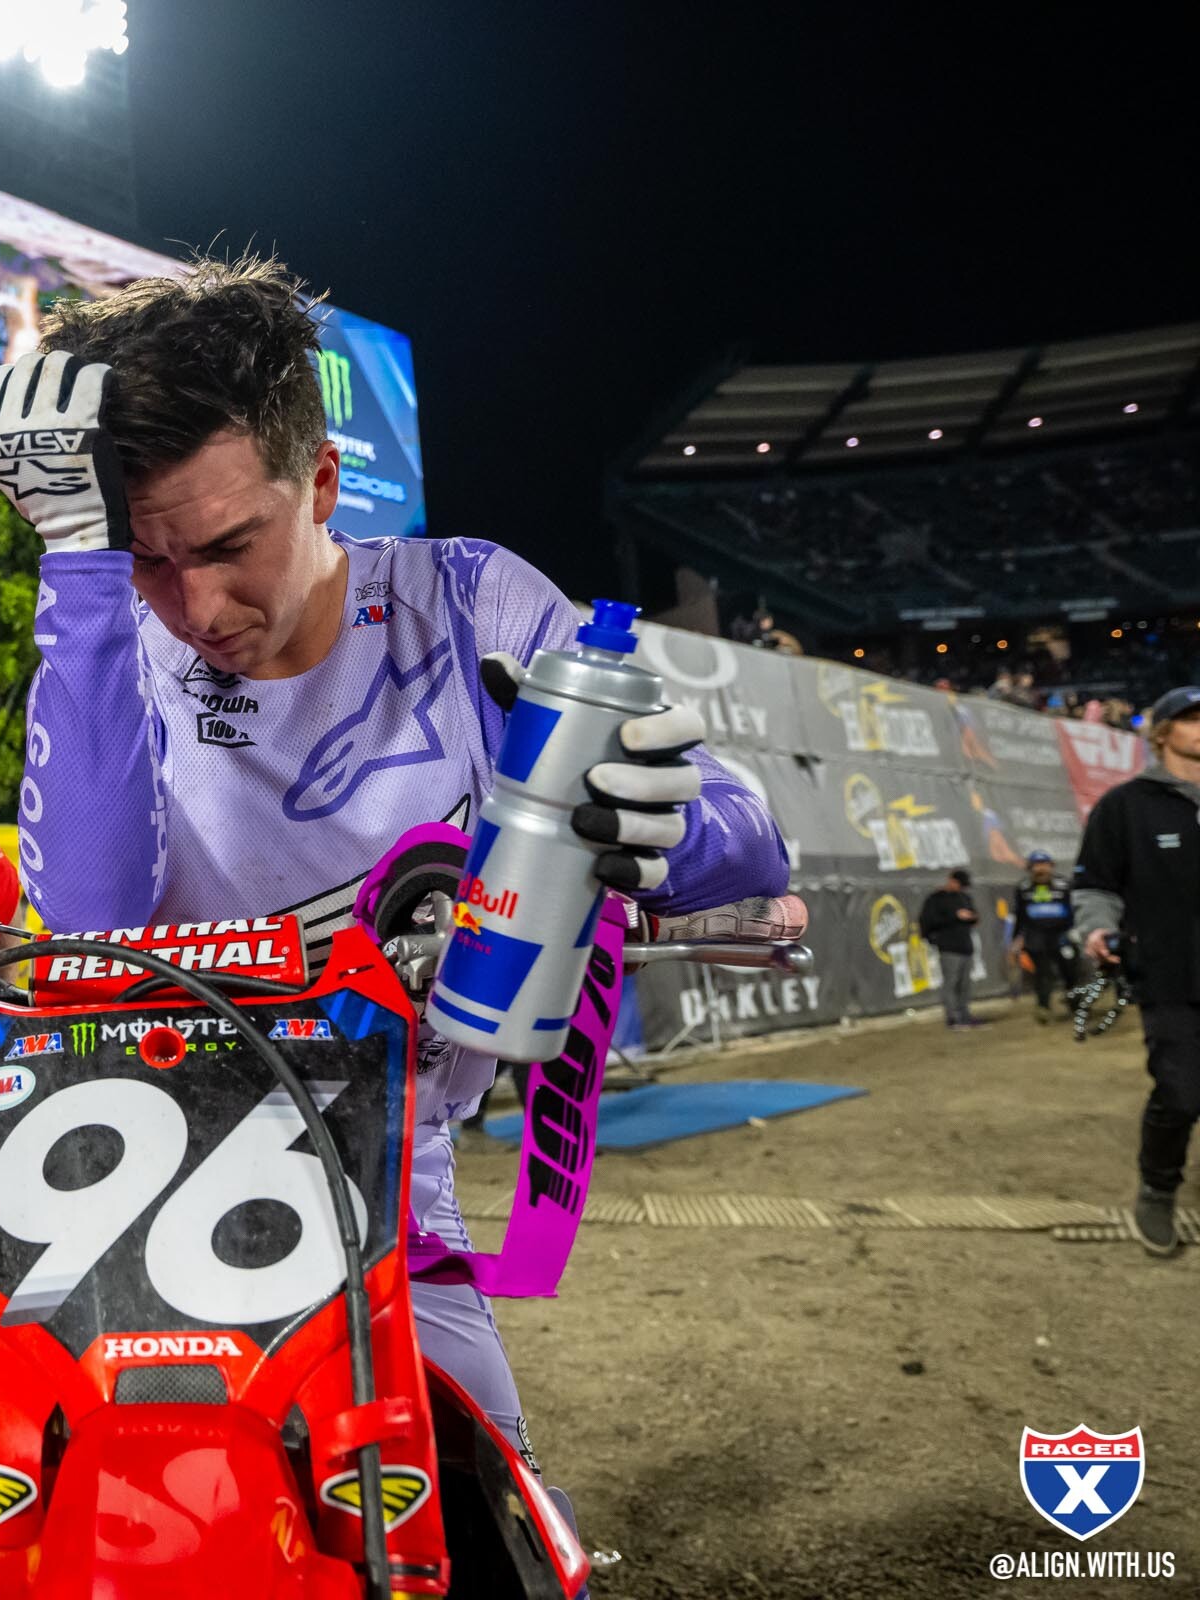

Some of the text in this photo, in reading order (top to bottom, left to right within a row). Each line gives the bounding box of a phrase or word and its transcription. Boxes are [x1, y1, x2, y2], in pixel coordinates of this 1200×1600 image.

[101, 1016, 240, 1044] MOSTE
[268, 1019, 333, 1040] AMA
[4, 1033, 64, 1061] AMA
[126, 1041, 236, 1056] ERGY
[105, 1337, 242, 1359] HONDA
